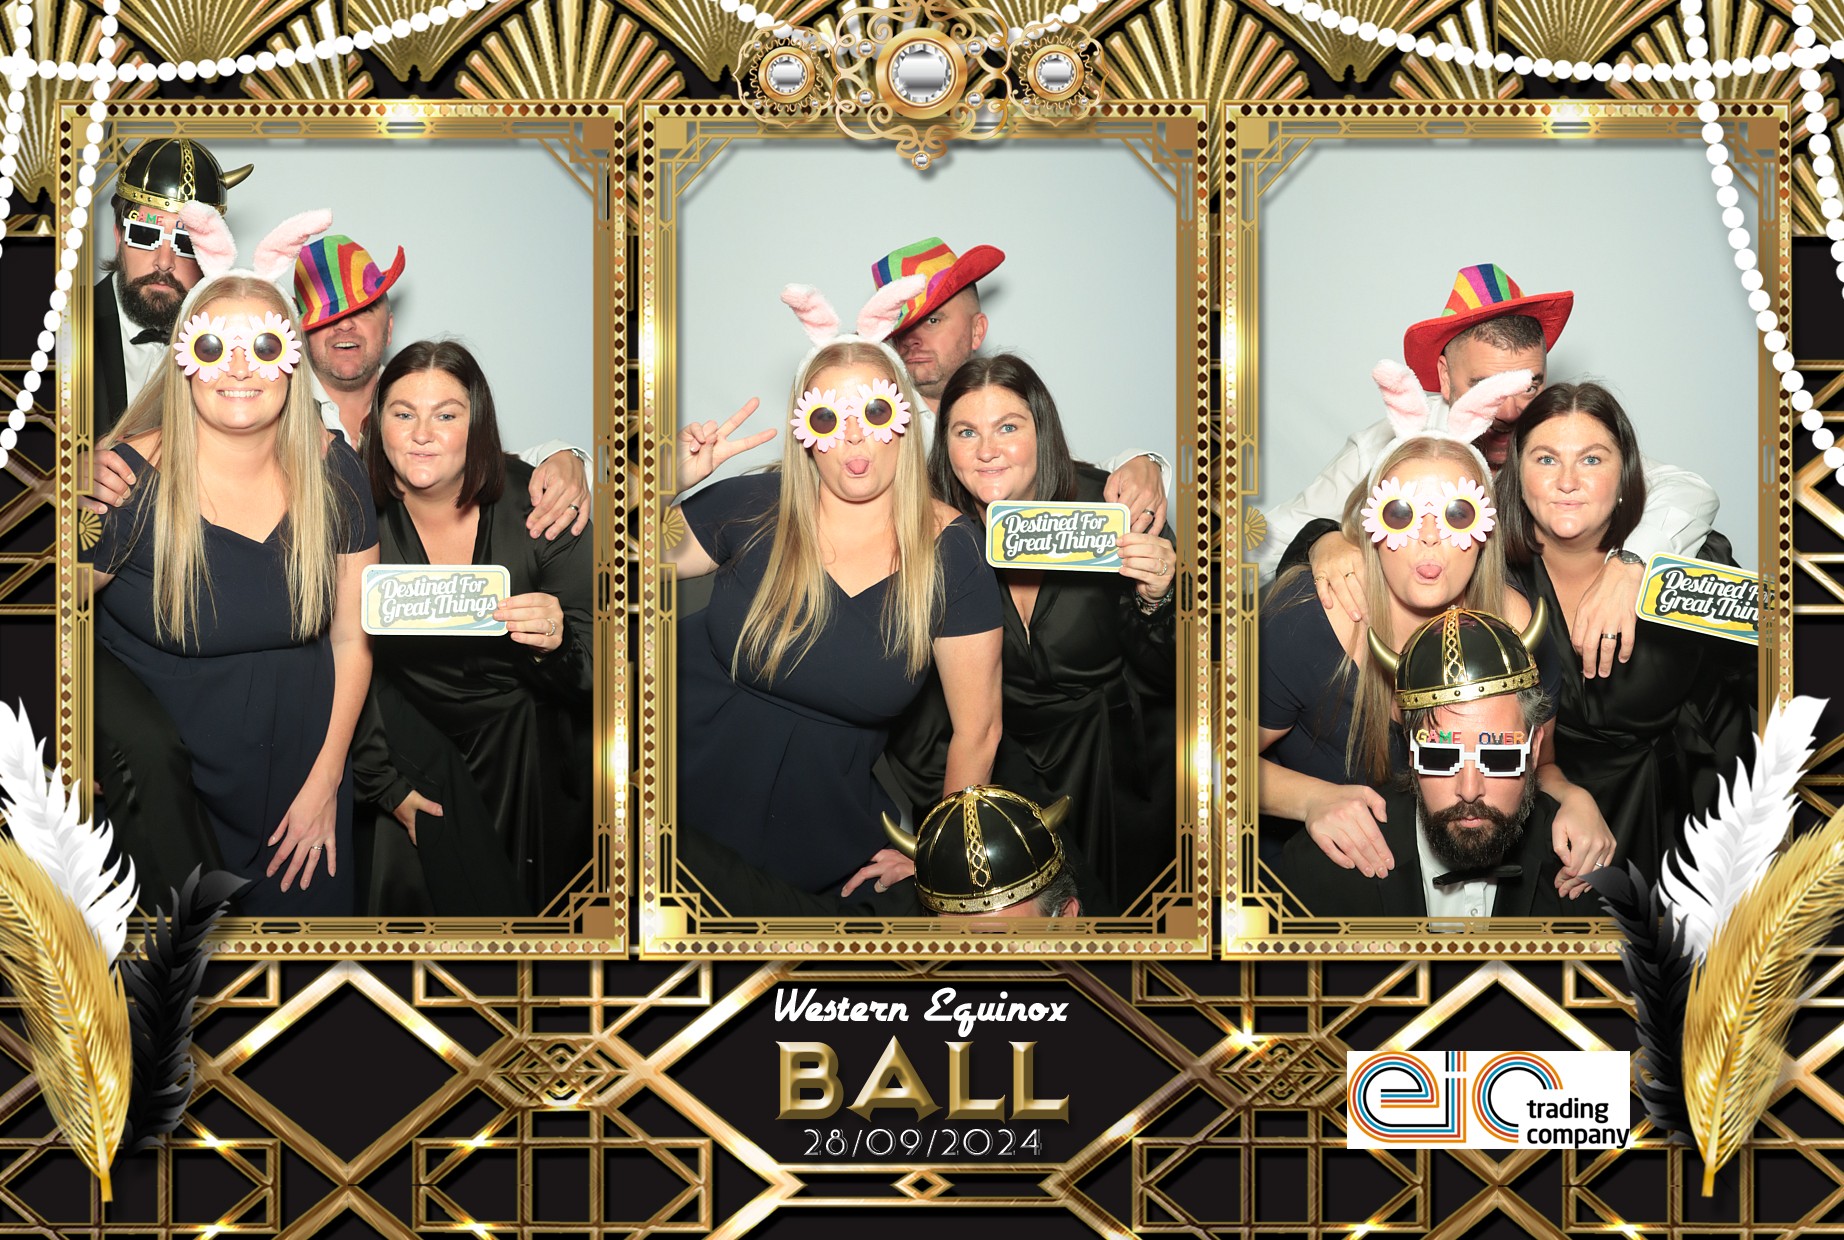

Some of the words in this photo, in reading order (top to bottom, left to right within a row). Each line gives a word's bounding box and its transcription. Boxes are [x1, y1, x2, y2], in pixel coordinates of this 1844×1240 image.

[129, 209, 164, 227] GAME
[1005, 512, 1077, 534] Destined
[1080, 513, 1107, 531] For
[1005, 533, 1053, 557] Great
[1055, 531, 1116, 554] Things
[382, 575, 457, 599] Destined
[460, 576, 487, 594] For
[1665, 570, 1750, 600] Destined
[382, 598, 432, 624] Great
[434, 594, 498, 618] Things
[1659, 589, 1715, 613] Great
[1716, 596, 1759, 622] Thin
[1416, 728, 1462, 744] GAME
[1479, 731, 1525, 745] OVER
